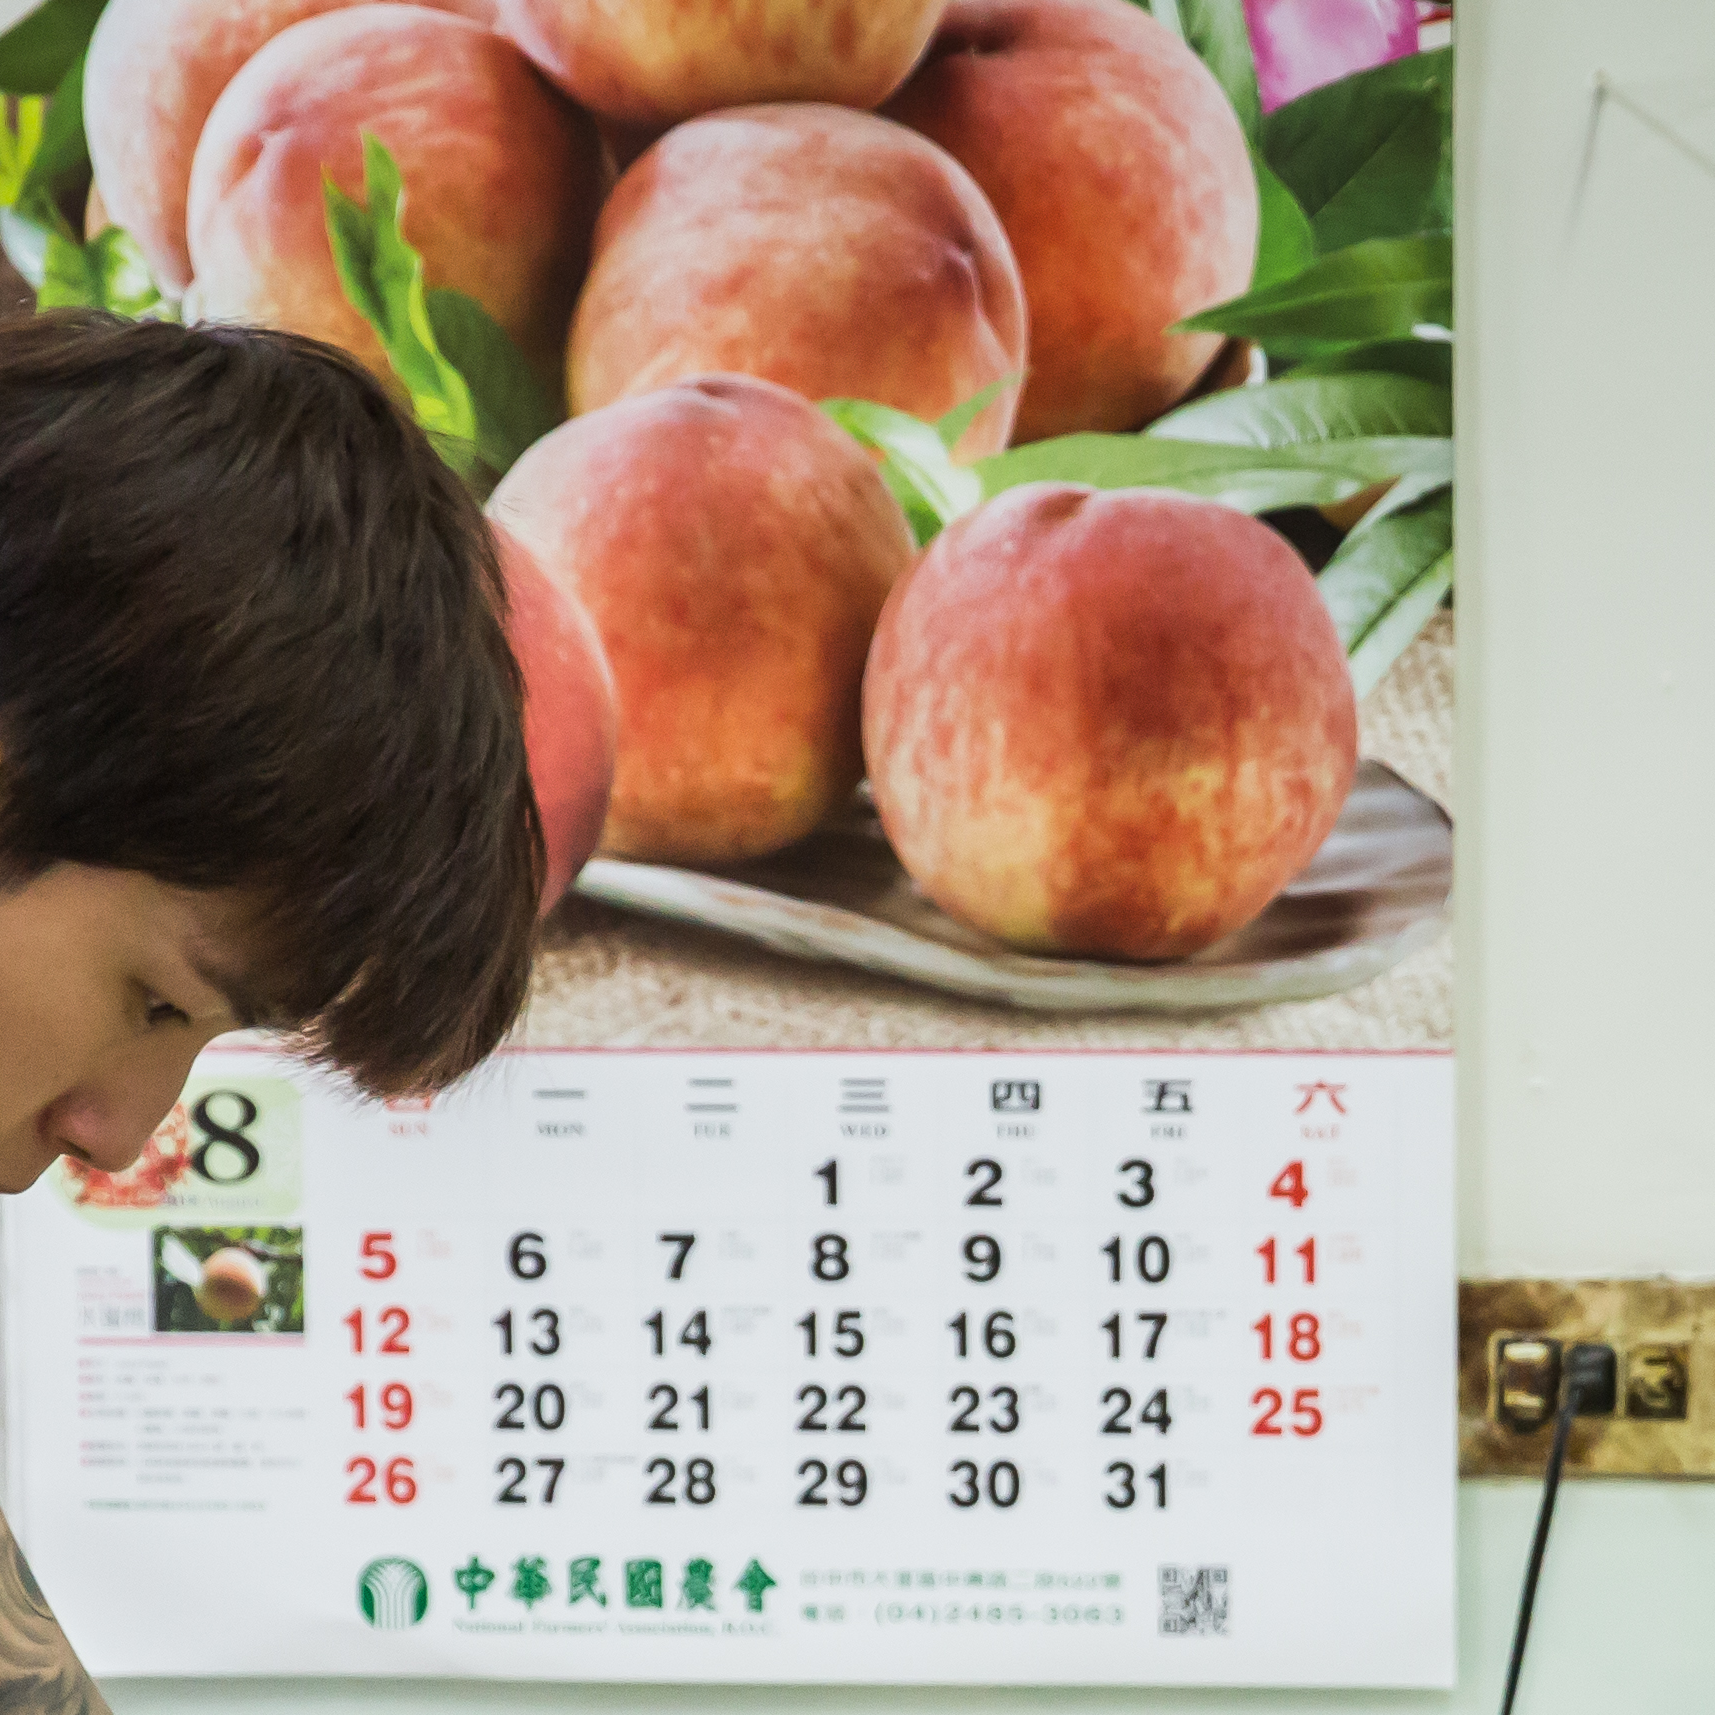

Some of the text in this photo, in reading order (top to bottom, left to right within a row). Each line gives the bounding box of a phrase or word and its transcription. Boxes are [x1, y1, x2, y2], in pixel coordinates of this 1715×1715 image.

[687, 1078, 740, 1115] 二
[839, 1078, 892, 1116] 三
[988, 1078, 1045, 1116] 四
[1143, 1078, 1197, 1117] 五
[1295, 1080, 1349, 1118] 六
[191, 1093, 261, 1184] 8
[814, 1158, 841, 1209] 1
[964, 1157, 1006, 1210] 2
[1116, 1158, 1158, 1212] 3
[1268, 1160, 1312, 1211] 4
[360, 1231, 400, 1284] 5
[507, 1230, 551, 1284] 6
[658, 1232, 699, 1284] 7
[810, 1232, 853, 1285] 8
[961, 1233, 1005, 1287] 9
[1101, 1233, 1174, 1287] 10
[1256, 1236, 1318, 1287] 11
[344, 1305, 413, 1357] 12
[493, 1307, 564, 1360] 13
[644, 1309, 715, 1360] 14
[796, 1309, 868, 1362] 15
[947, 1309, 1019, 1363] 16
[1101, 1311, 1171, 1363] 17
[1252, 1311, 1325, 1364] 18
[346, 1381, 416, 1434] 19
[493, 1382, 569, 1434] 20
[647, 1382, 713, 1434] 21
[796, 1383, 870, 1436] 22
[948, 1384, 1023, 1437] 23
[1100, 1385, 1175, 1438] 24
[1251, 1386, 1326, 1440] 25
[346, 1455, 1170, 1513] 26 27 28 29 30 31
[453, 1554, 778, 1613] 中華民國農會
